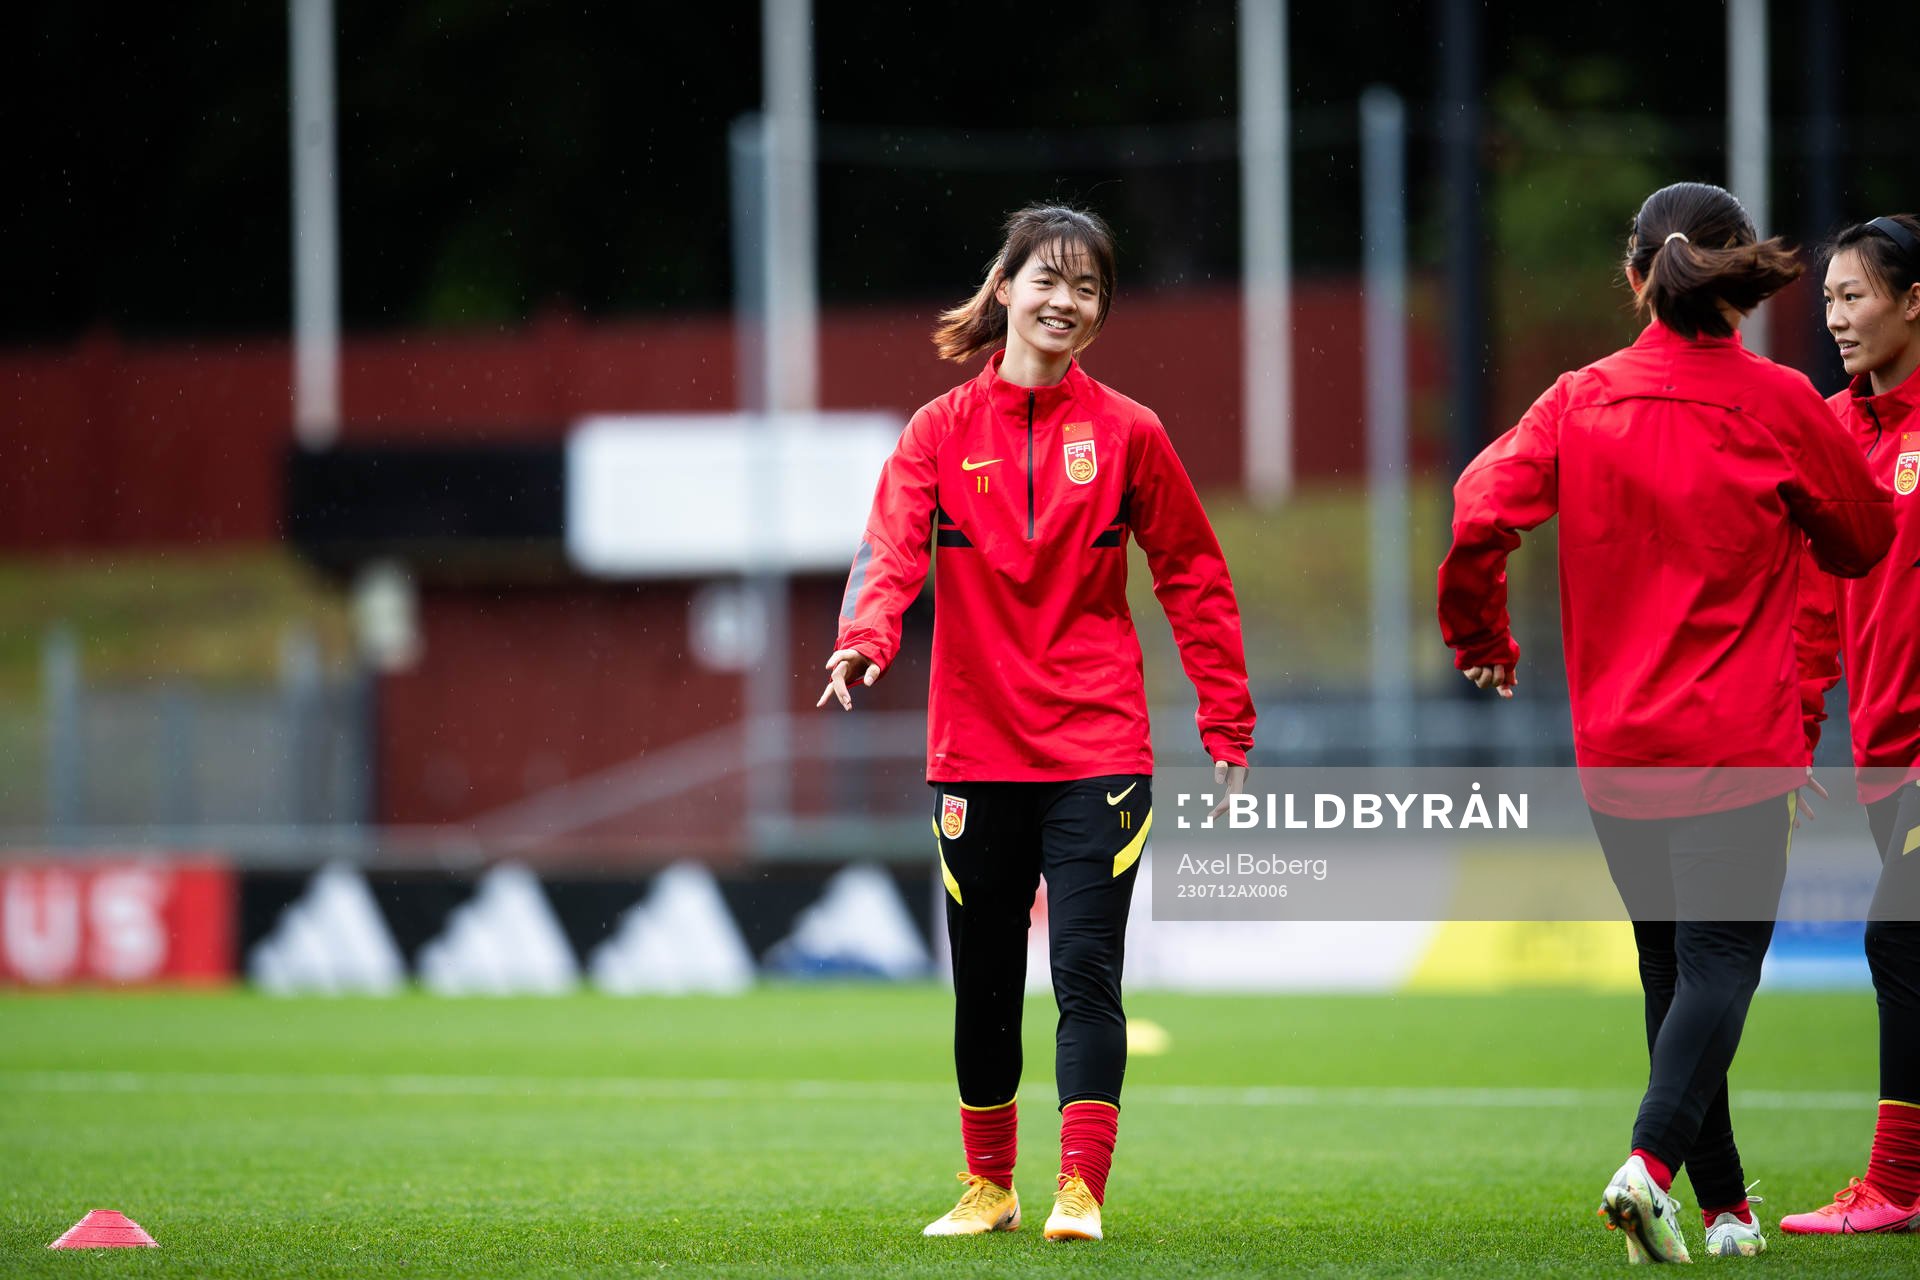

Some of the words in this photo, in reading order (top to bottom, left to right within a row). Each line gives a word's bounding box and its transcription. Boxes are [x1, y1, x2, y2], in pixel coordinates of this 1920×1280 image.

[1068, 444, 1091, 454] CFA
[1901, 456, 1918, 464] CFA
[976, 475, 989, 494] 11
[945, 798, 963, 809] CFA
[1119, 810, 1131, 830] 11
